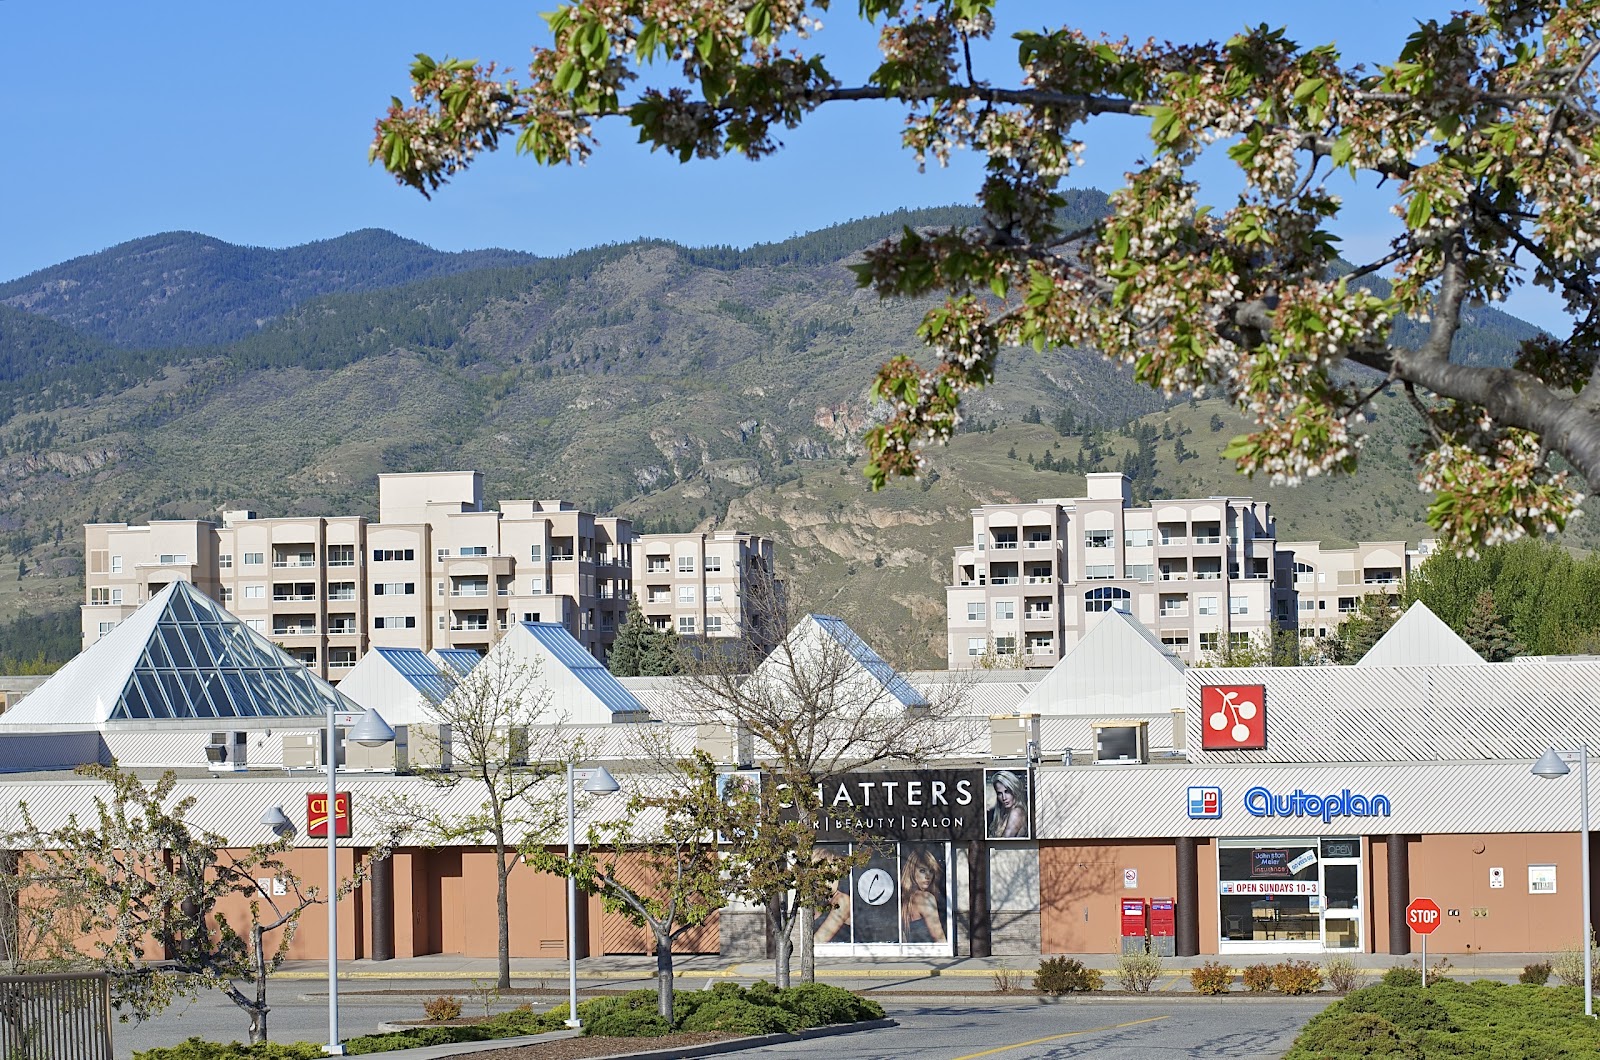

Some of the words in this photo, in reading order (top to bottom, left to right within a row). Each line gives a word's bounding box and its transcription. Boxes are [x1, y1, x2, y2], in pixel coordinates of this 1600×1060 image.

[310, 799, 345, 814] CIC
[1244, 786, 1391, 823] Autoplan
[835, 817, 895, 829] BEAUTY
[911, 817, 964, 828] SALON
[1328, 845, 1353, 854] OPEN
[1236, 883, 1257, 893] OPEN
[1259, 883, 1294, 893] SUNDAYS
[1410, 909, 1438, 923] STOP
